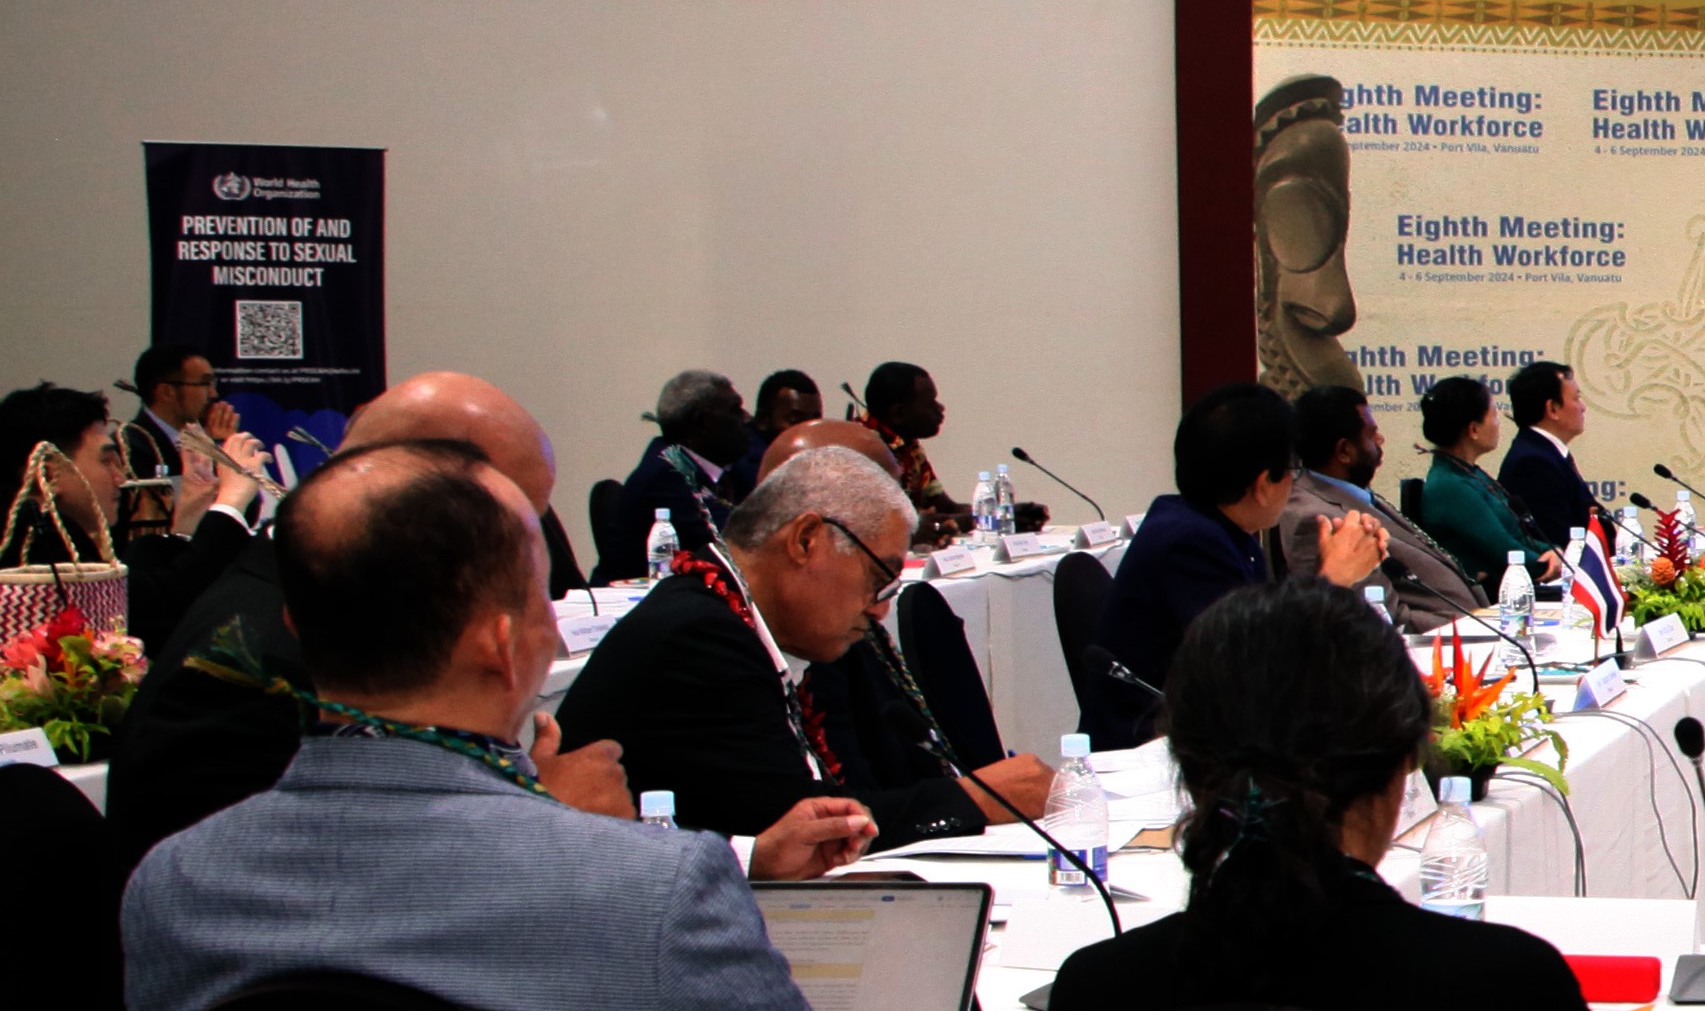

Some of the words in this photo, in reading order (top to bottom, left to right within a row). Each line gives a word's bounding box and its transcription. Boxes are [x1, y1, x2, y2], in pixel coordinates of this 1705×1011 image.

[1341, 83, 1402, 109] ghth
[1414, 85, 1542, 114] Meeting:
[1593, 89, 1680, 115] Eighth
[1341, 113, 1397, 134] alth
[1407, 114, 1543, 137] Workforce
[1592, 118, 1675, 140] Health
[253, 177, 284, 188] World
[287, 178, 320, 189] Health
[253, 188, 321, 200] Organization
[182, 216, 287, 236] PREVENTION
[292, 218, 312, 237] OF
[316, 218, 351, 238] AND
[1397, 214, 1488, 240] Eighth
[1499, 216, 1624, 244] Meeting:
[178, 242, 265, 261] RESPONSE
[270, 243, 289, 261] TO
[294, 243, 356, 263] SEXUAL
[1397, 244, 1482, 266] Health
[1493, 245, 1626, 267] Workforce
[213, 267, 323, 287] MISCONDUCT
[1425, 272, 1484, 283] September
[1488, 273, 1514, 282] 2024
[1525, 273, 1547, 282] Port
[1577, 274, 1622, 283] Vanuatu
[1366, 374, 1400, 396] lth
